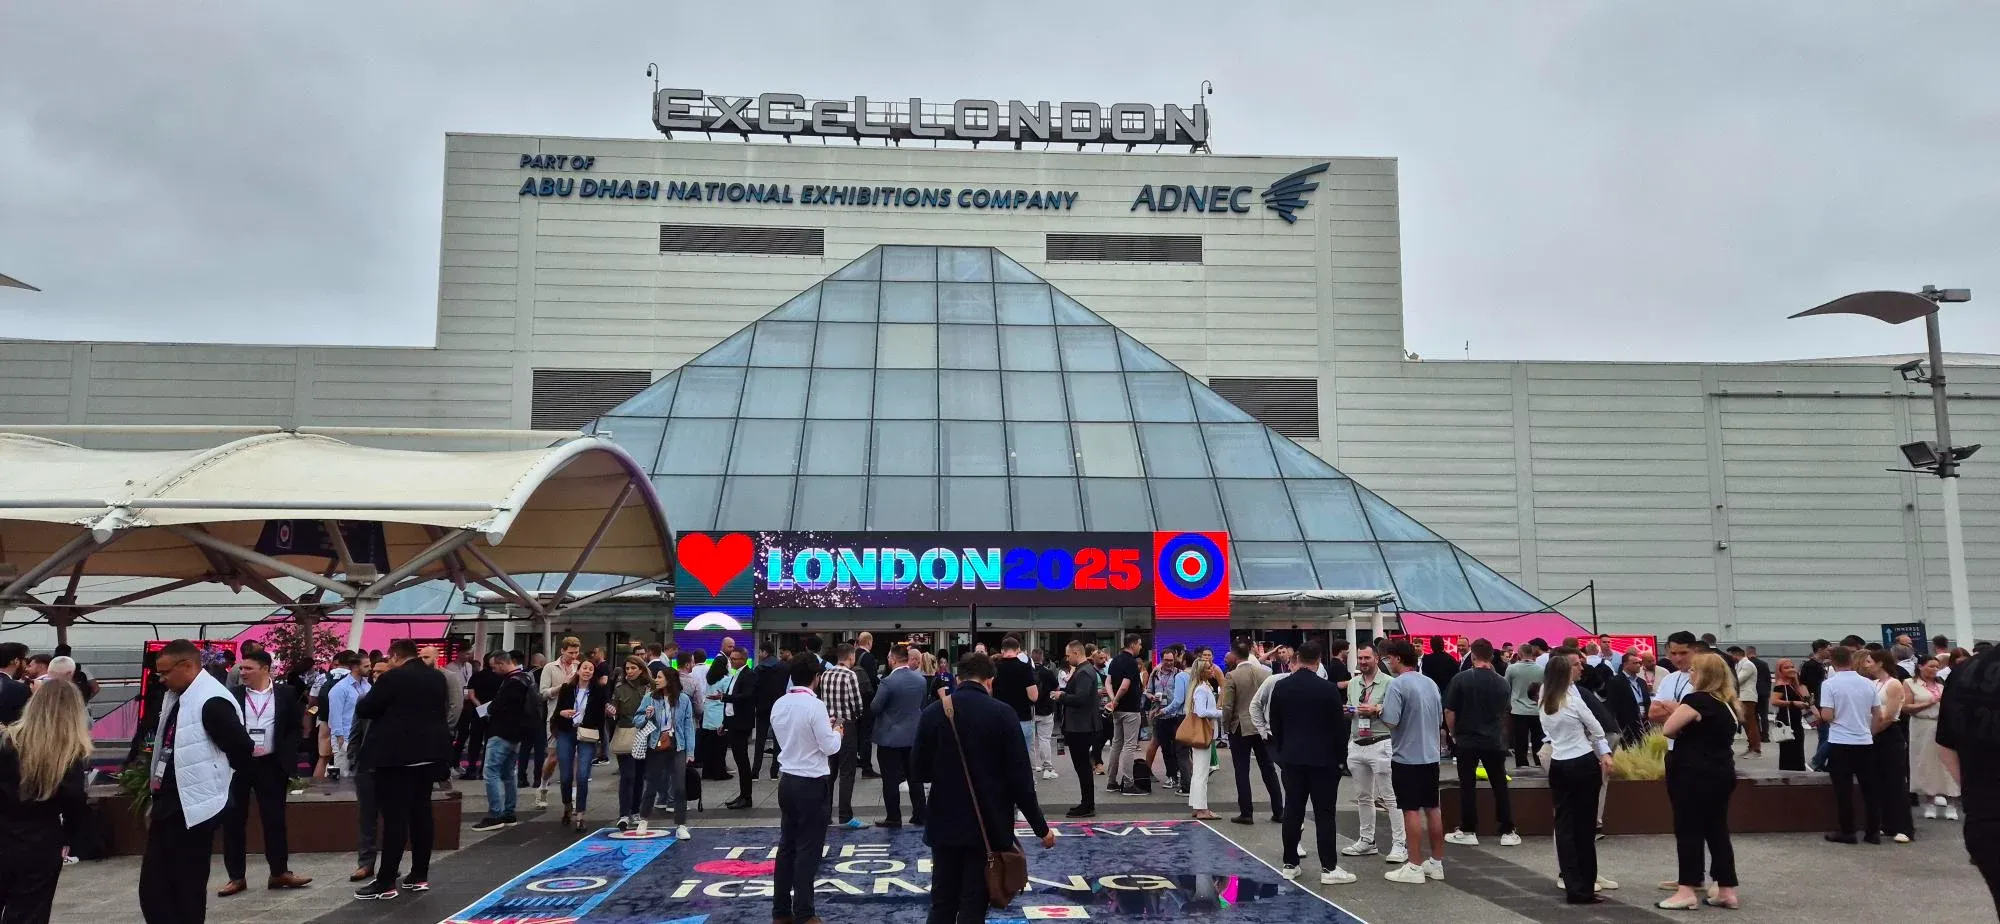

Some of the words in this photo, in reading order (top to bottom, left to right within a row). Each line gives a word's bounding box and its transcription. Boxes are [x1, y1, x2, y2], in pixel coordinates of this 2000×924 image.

[909, 97, 1205, 142] LONDON
[519, 153, 566, 170] PART
[569, 154, 595, 170] OF
[519, 177, 574, 198] ABU
[579, 178, 660, 200] DHABI
[666, 180, 794, 204] NATIONAL
[800, 184, 952, 208] EXHIBITIONS
[957, 188, 1079, 210] COMPANY
[1130, 184, 1253, 213] ADNEC
